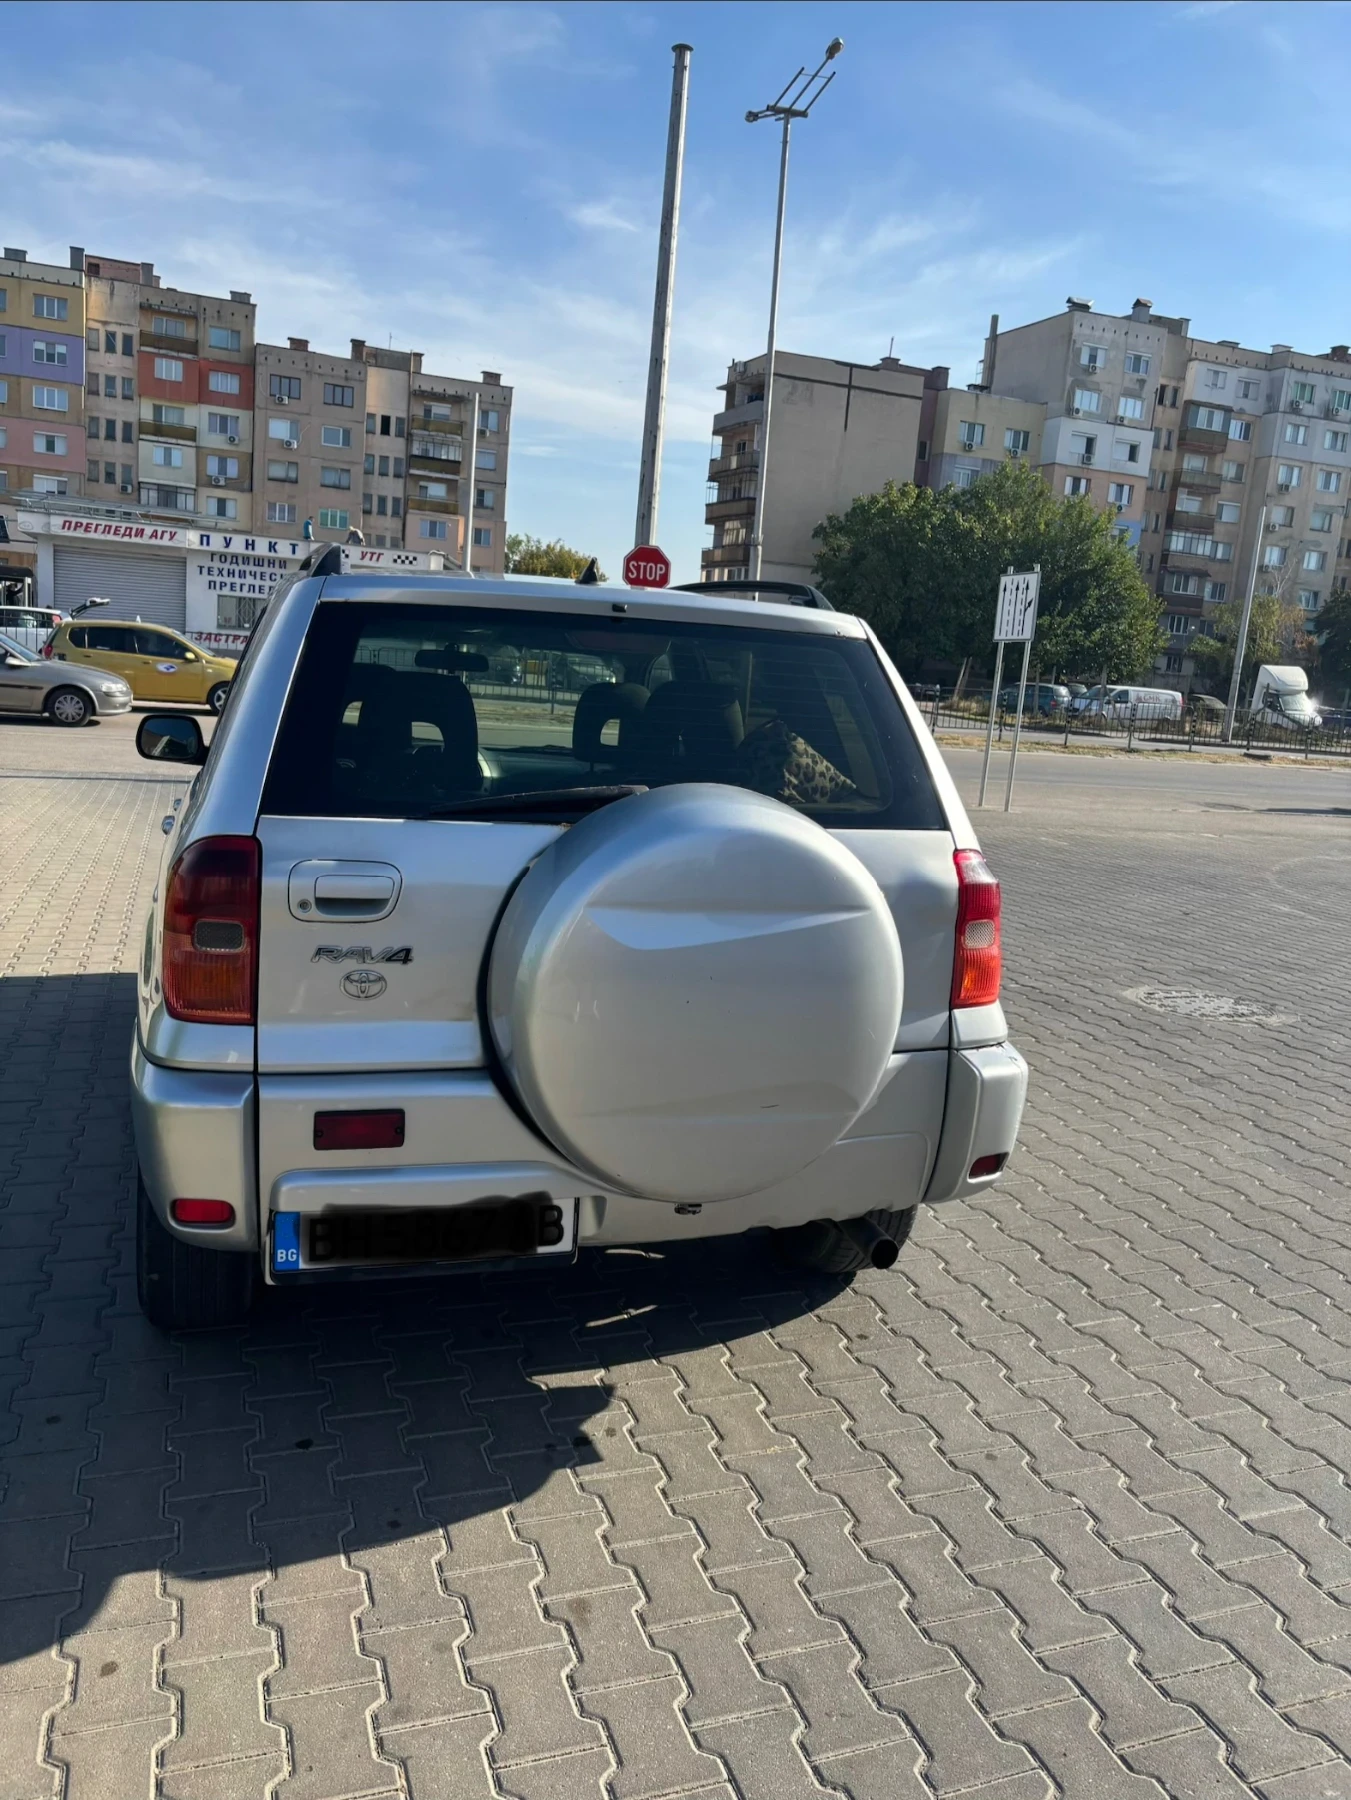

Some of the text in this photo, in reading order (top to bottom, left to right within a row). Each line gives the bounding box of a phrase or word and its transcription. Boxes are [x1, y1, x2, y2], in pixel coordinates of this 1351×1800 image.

[61, 519, 178, 541] ПРЕГЛЕДИ АГУ
[200, 534, 299, 556] ПУНКТ
[210, 552, 287, 570] ГОДИШНИ
[628, 560, 666, 581] STOP
[197, 565, 284, 582] ТЕХНИЧЕС
[310, 945, 414, 965] RAV4
[277, 1248, 298, 1263] BG
